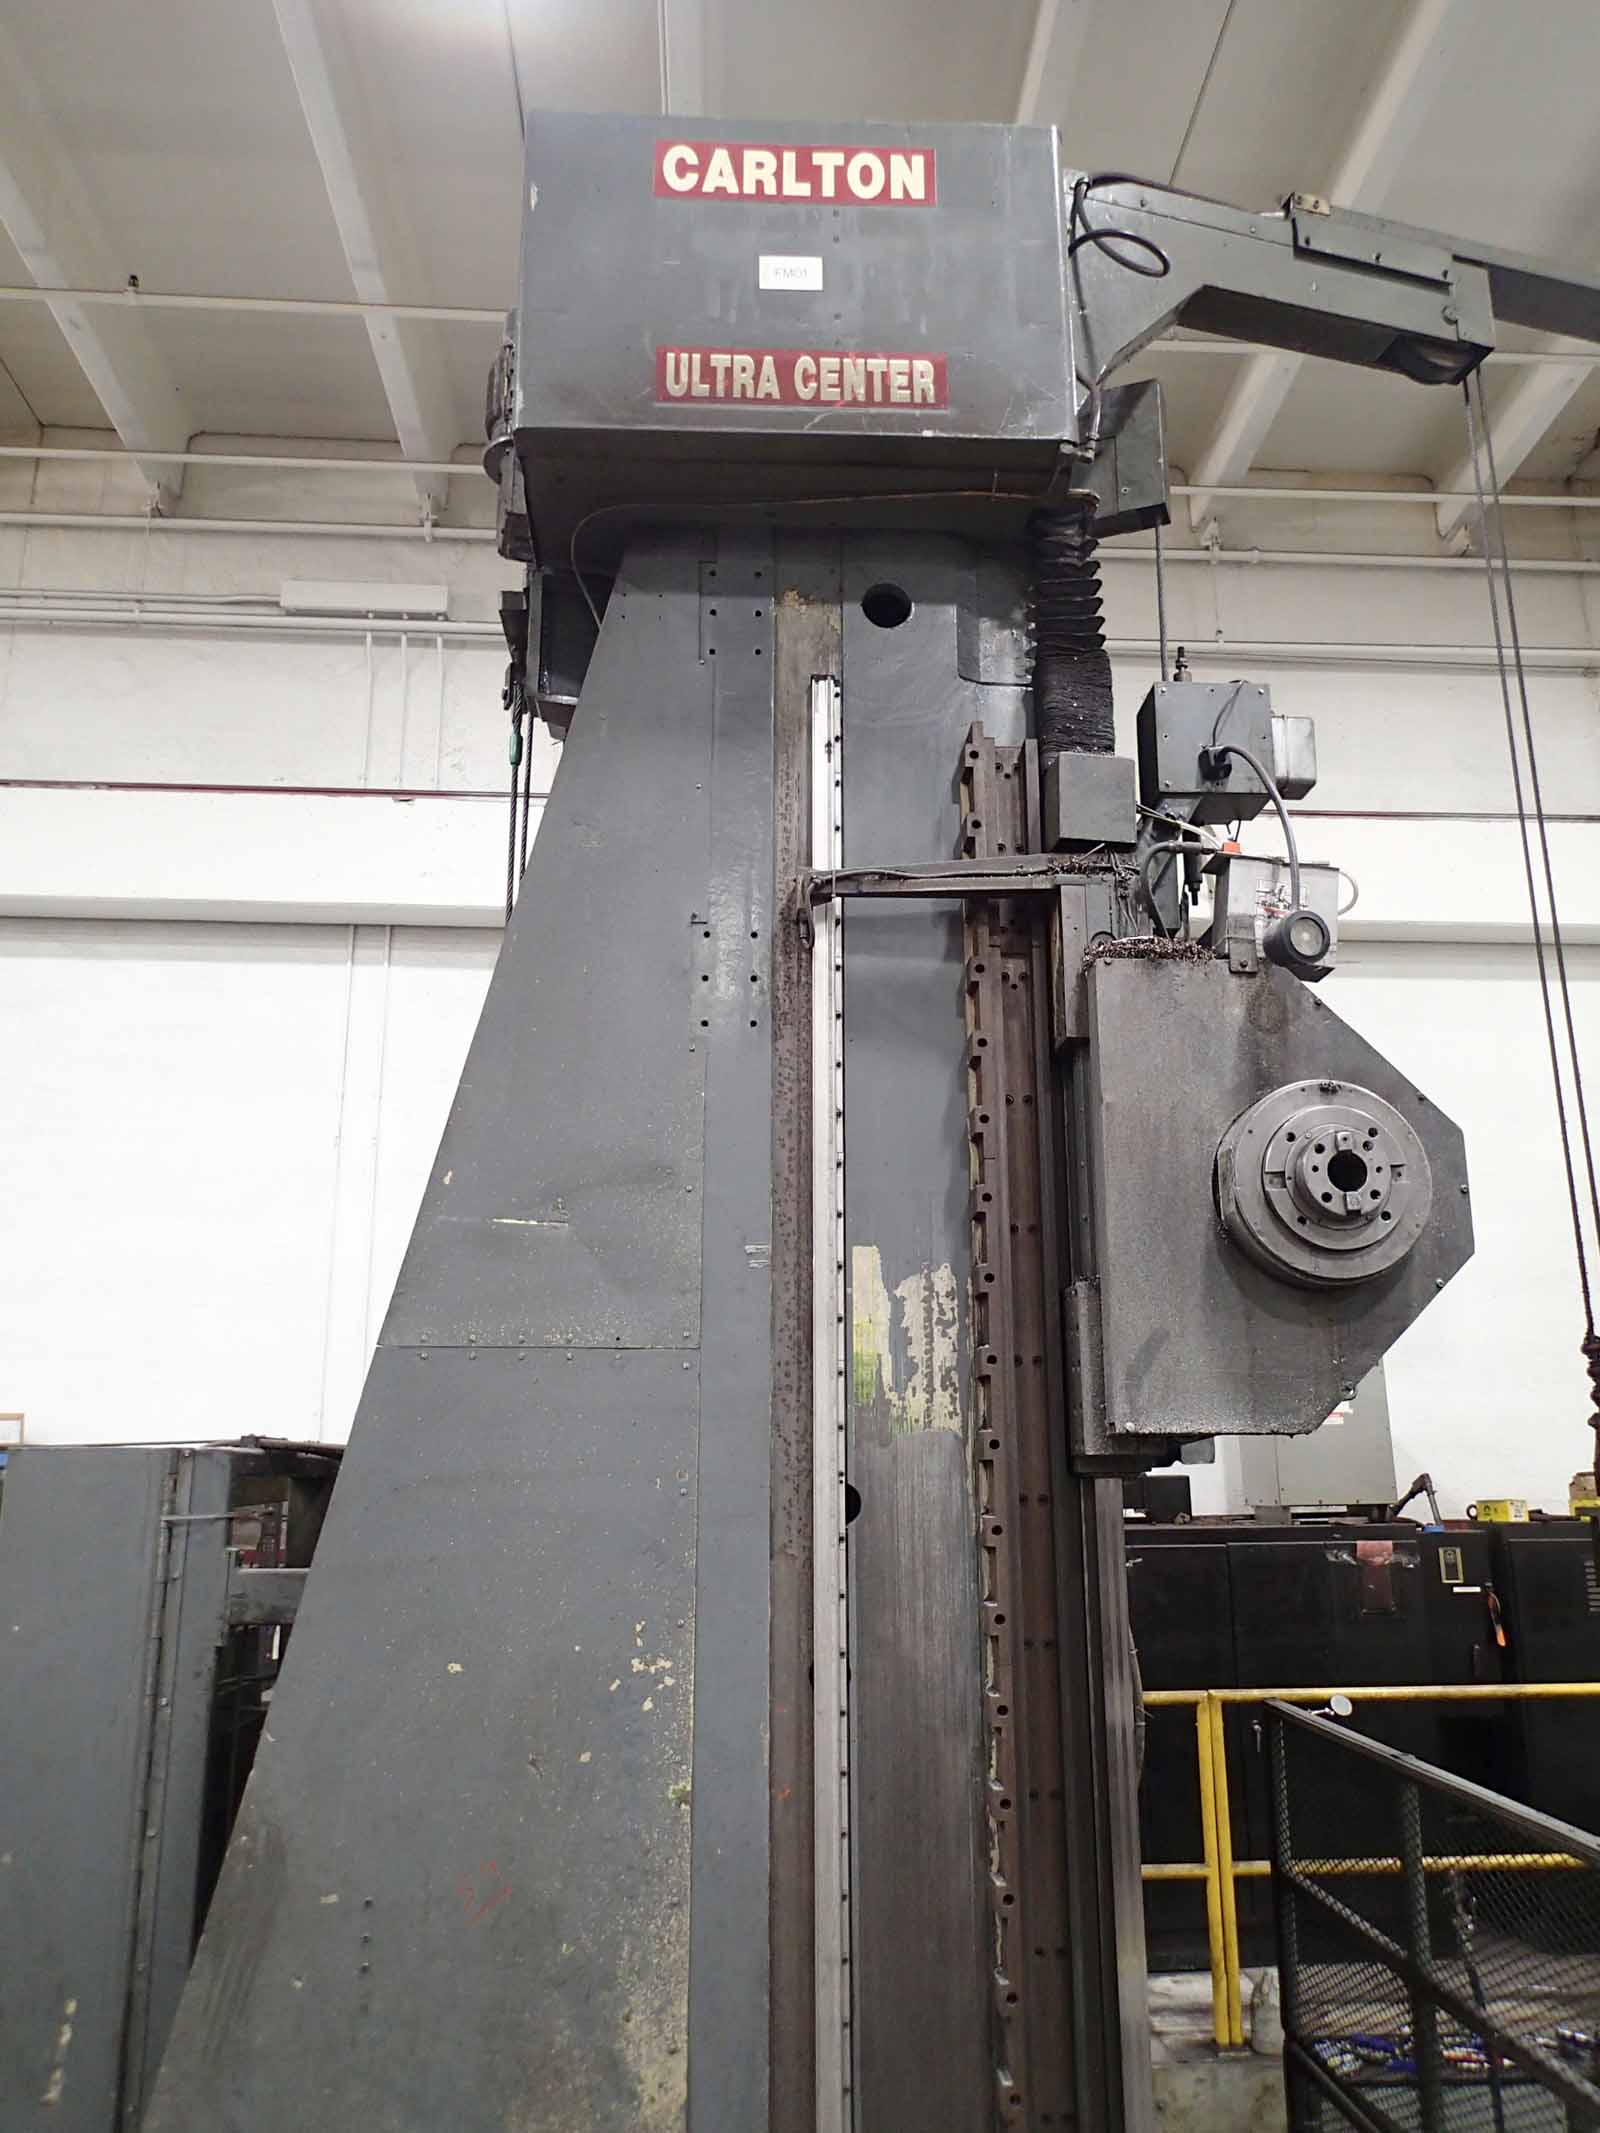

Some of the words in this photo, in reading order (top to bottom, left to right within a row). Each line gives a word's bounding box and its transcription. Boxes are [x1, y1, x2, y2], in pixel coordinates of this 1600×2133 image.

[663, 145, 925, 200] CARLTON
[666, 352, 780, 399] ULTRA
[793, 355, 936, 403] CENTER
